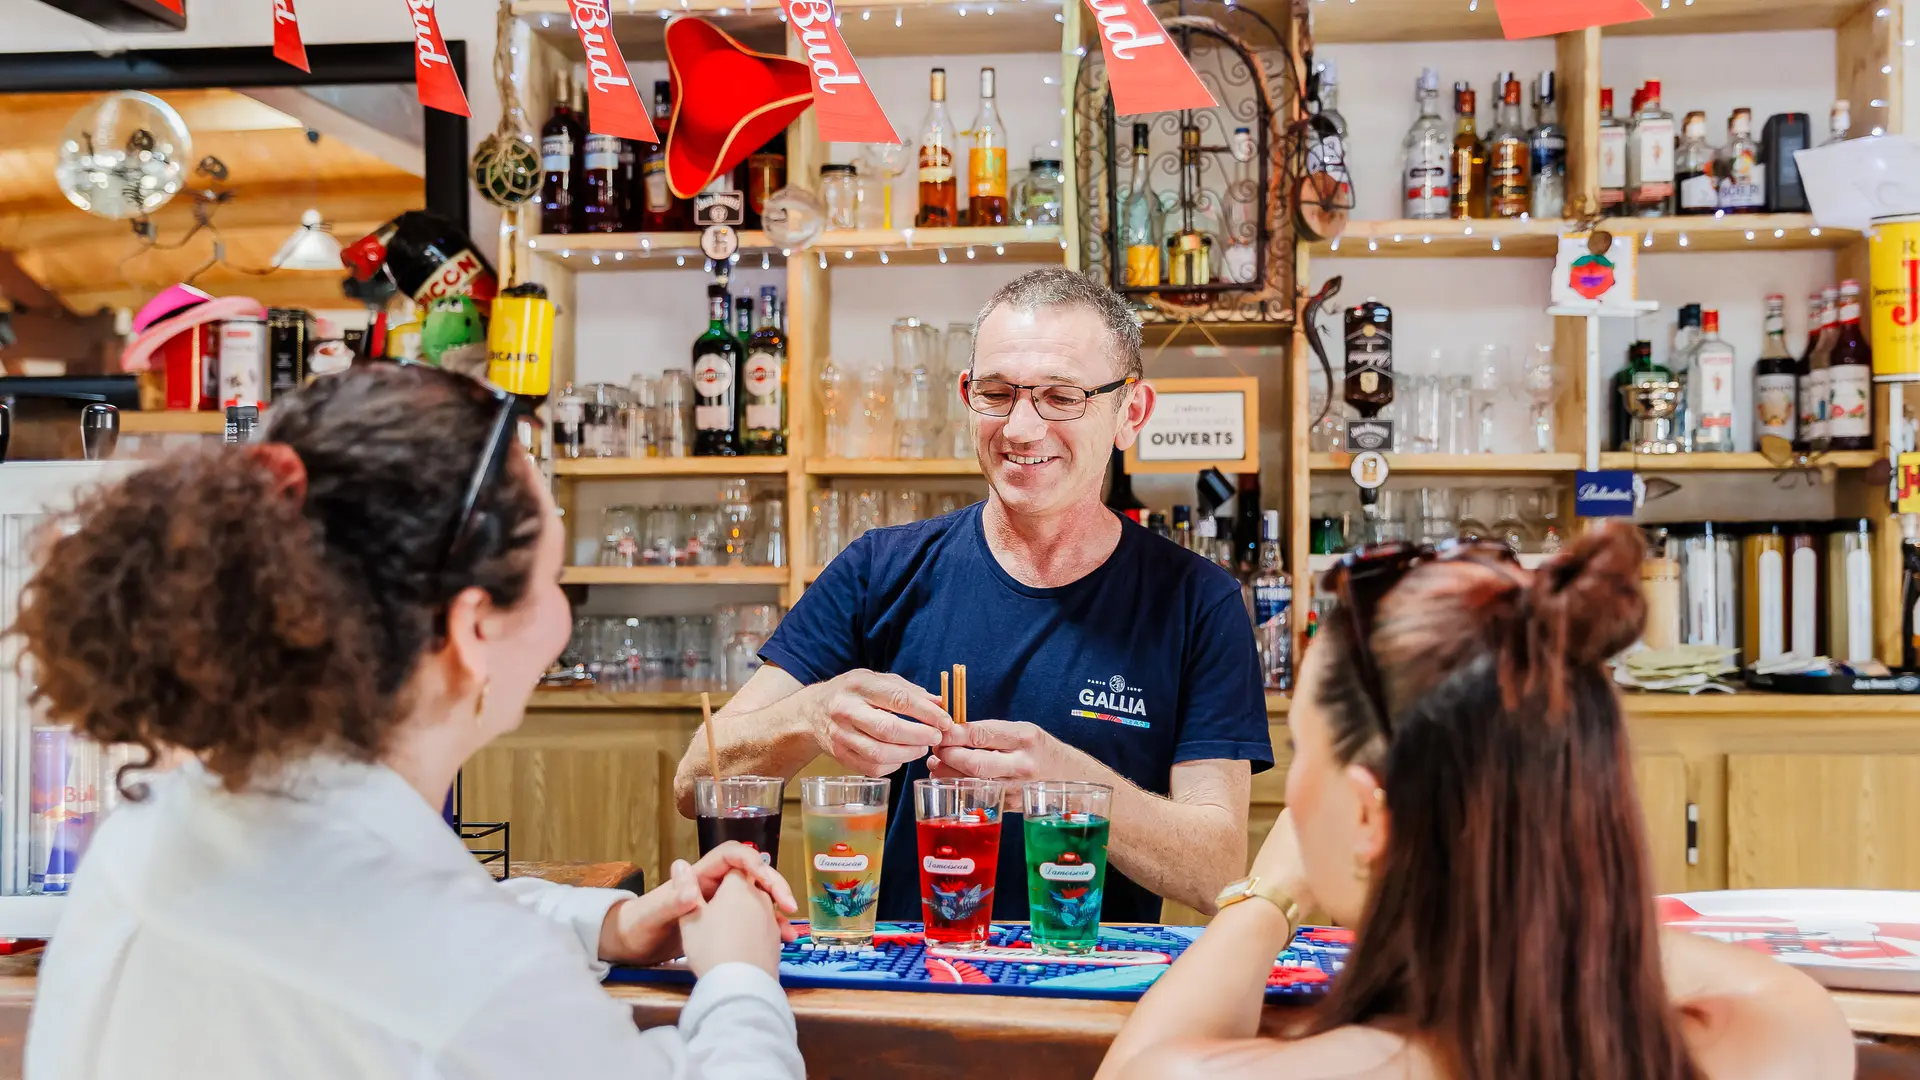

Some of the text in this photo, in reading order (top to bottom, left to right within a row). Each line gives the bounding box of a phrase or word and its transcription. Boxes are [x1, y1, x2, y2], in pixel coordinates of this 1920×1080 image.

[573, 0, 630, 93] Bud
[789, 0, 860, 94] Bud
[1089, 0, 1165, 60] ud
[1151, 432, 1233, 446] OUVERTS
[1078, 688, 1147, 716] GALLIA
